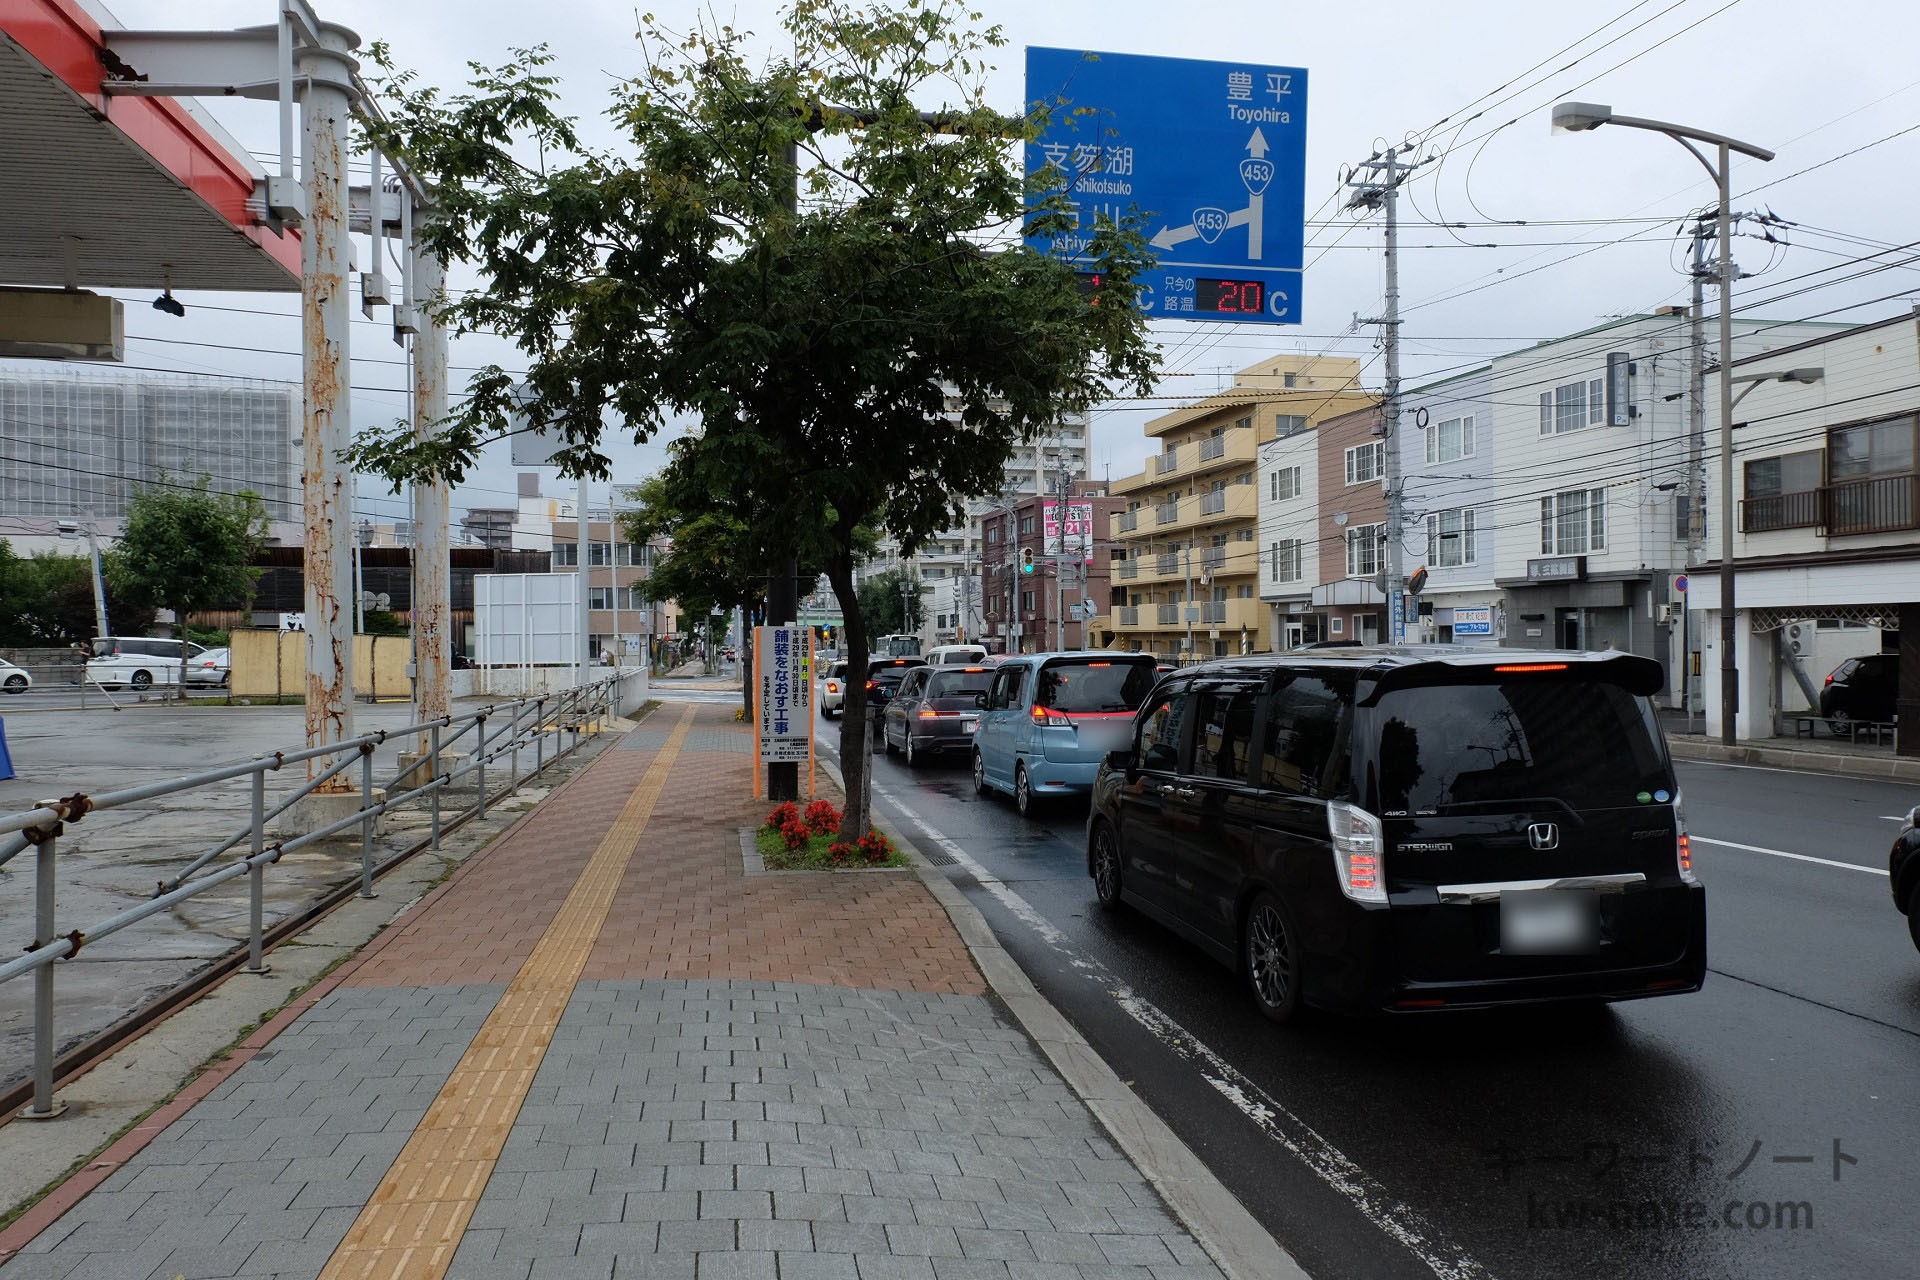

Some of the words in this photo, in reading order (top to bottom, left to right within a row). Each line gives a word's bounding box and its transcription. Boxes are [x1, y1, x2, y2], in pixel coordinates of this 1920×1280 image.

[1227, 72, 1292, 103] 豊平
[1228, 104, 1290, 124] Toyohira
[1042, 141, 1133, 176] 支笏湖
[1244, 165, 1269, 182] 453
[1075, 177, 1132, 196] Shikotsuko
[1198, 214, 1223, 230] 453
[1164, 275, 1194, 291] 只今の
[1164, 296, 1194, 312] 路温
[1218, 281, 1260, 313] 20
[774, 629, 789, 735] 舗装をなおす工事
